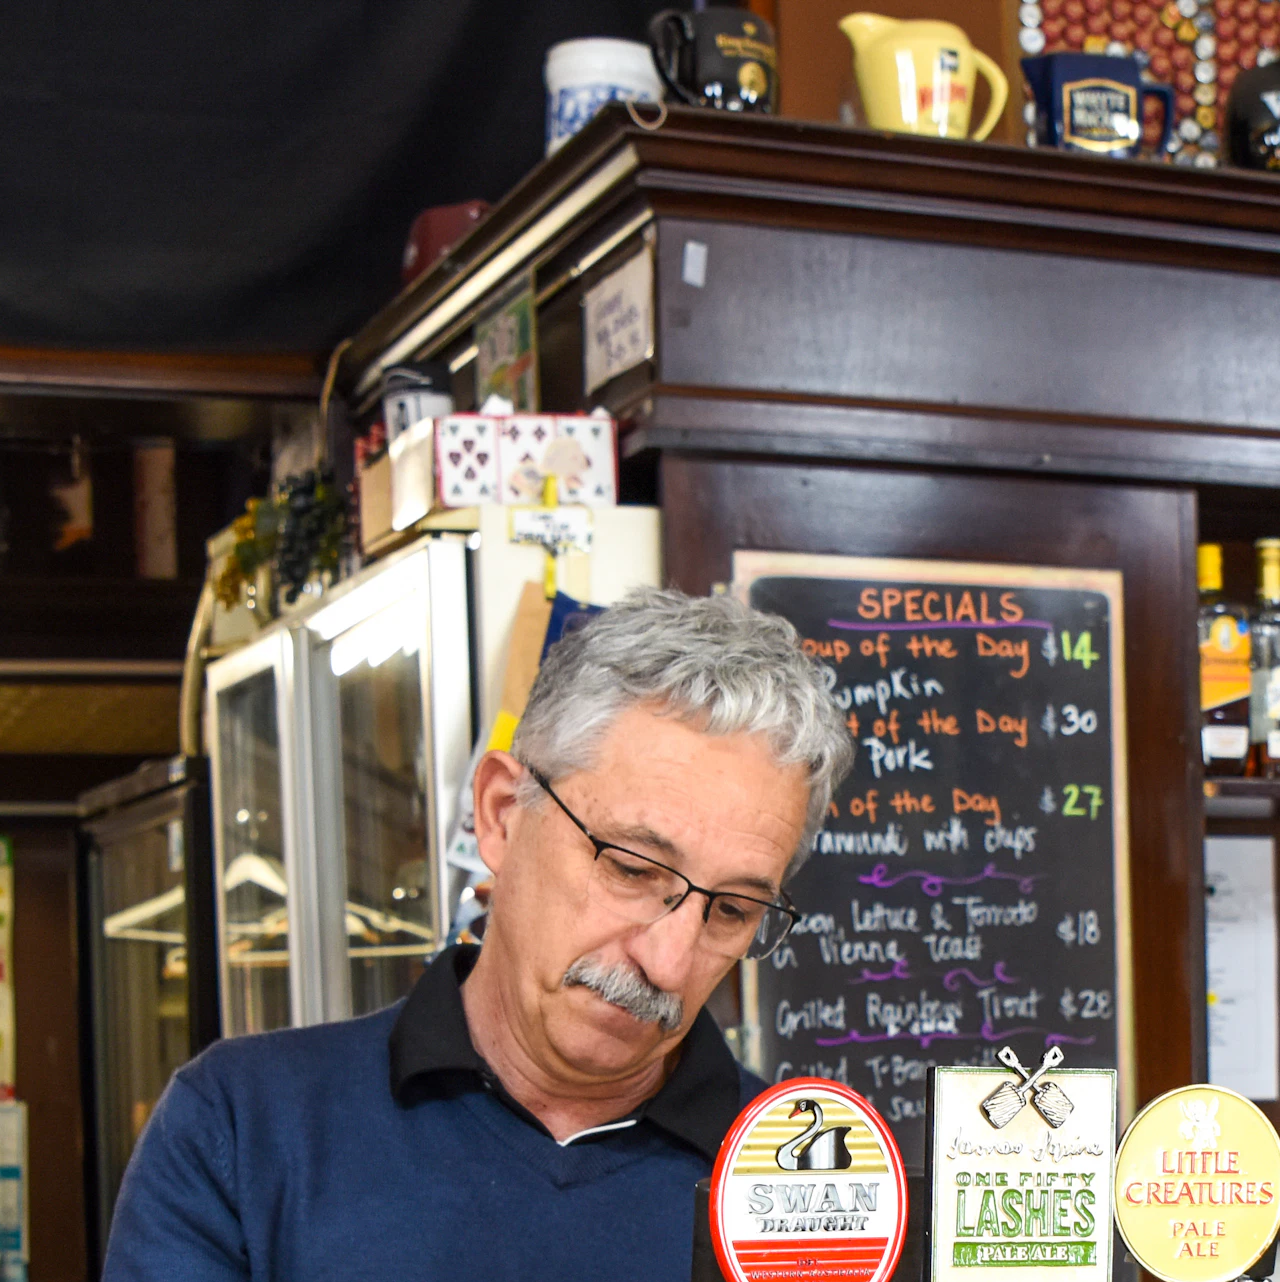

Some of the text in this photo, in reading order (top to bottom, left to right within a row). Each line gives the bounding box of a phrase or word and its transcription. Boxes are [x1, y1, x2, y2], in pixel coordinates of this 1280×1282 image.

[858, 587, 1023, 624] SPECIALS
[800, 637, 851, 664] oup
[860, 632, 891, 667] of
[906, 633, 959, 658] the
[976, 632, 1030, 678] Day
[873, 710, 900, 744] of
[917, 708, 961, 735] the
[976, 709, 1029, 748] Day
[861, 737, 934, 779] Pork
[850, 789, 878, 823] of
[890, 789, 935, 814] the
[952, 788, 1001, 826] Day
[946, 1126, 1104, 1163] James Squire
[955, 1172, 1096, 1187] ONE FIFTY
[1161, 1151, 1240, 1175] LITTLE
[748, 1183, 880, 1216] SWAN
[1125, 1181, 1274, 1206] CREATURES
[759, 1215, 869, 1233] DRAUGHT
[955, 1188, 1097, 1238] LASHES
[1172, 1221, 1226, 1237] PALE
[981, 1244, 1071, 1262] PALE ALE
[1178, 1242, 1220, 1258] ALE
